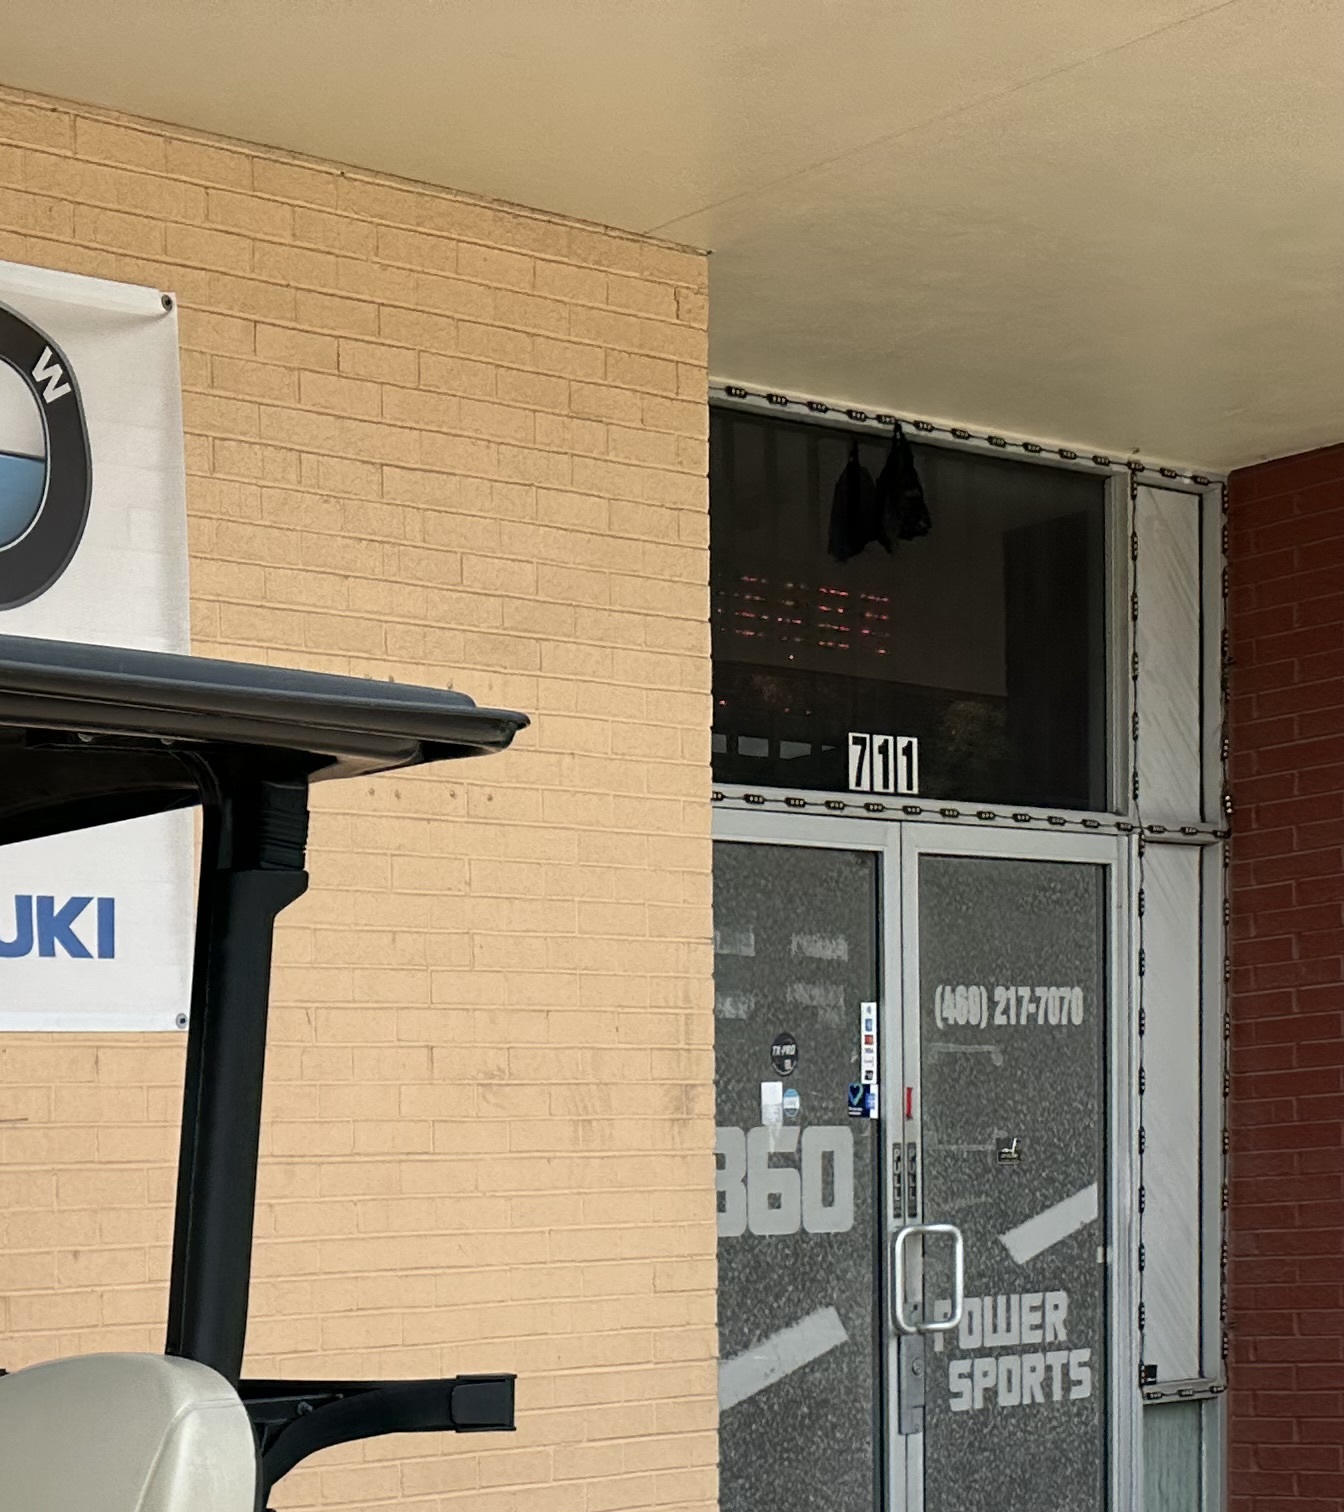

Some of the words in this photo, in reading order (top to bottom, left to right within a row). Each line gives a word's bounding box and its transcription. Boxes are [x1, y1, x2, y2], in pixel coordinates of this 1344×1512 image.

[851, 735, 916, 791] 711
[993, 985, 1084, 1027] 217-7070
[948, 1347, 1092, 1412] SPORTS
